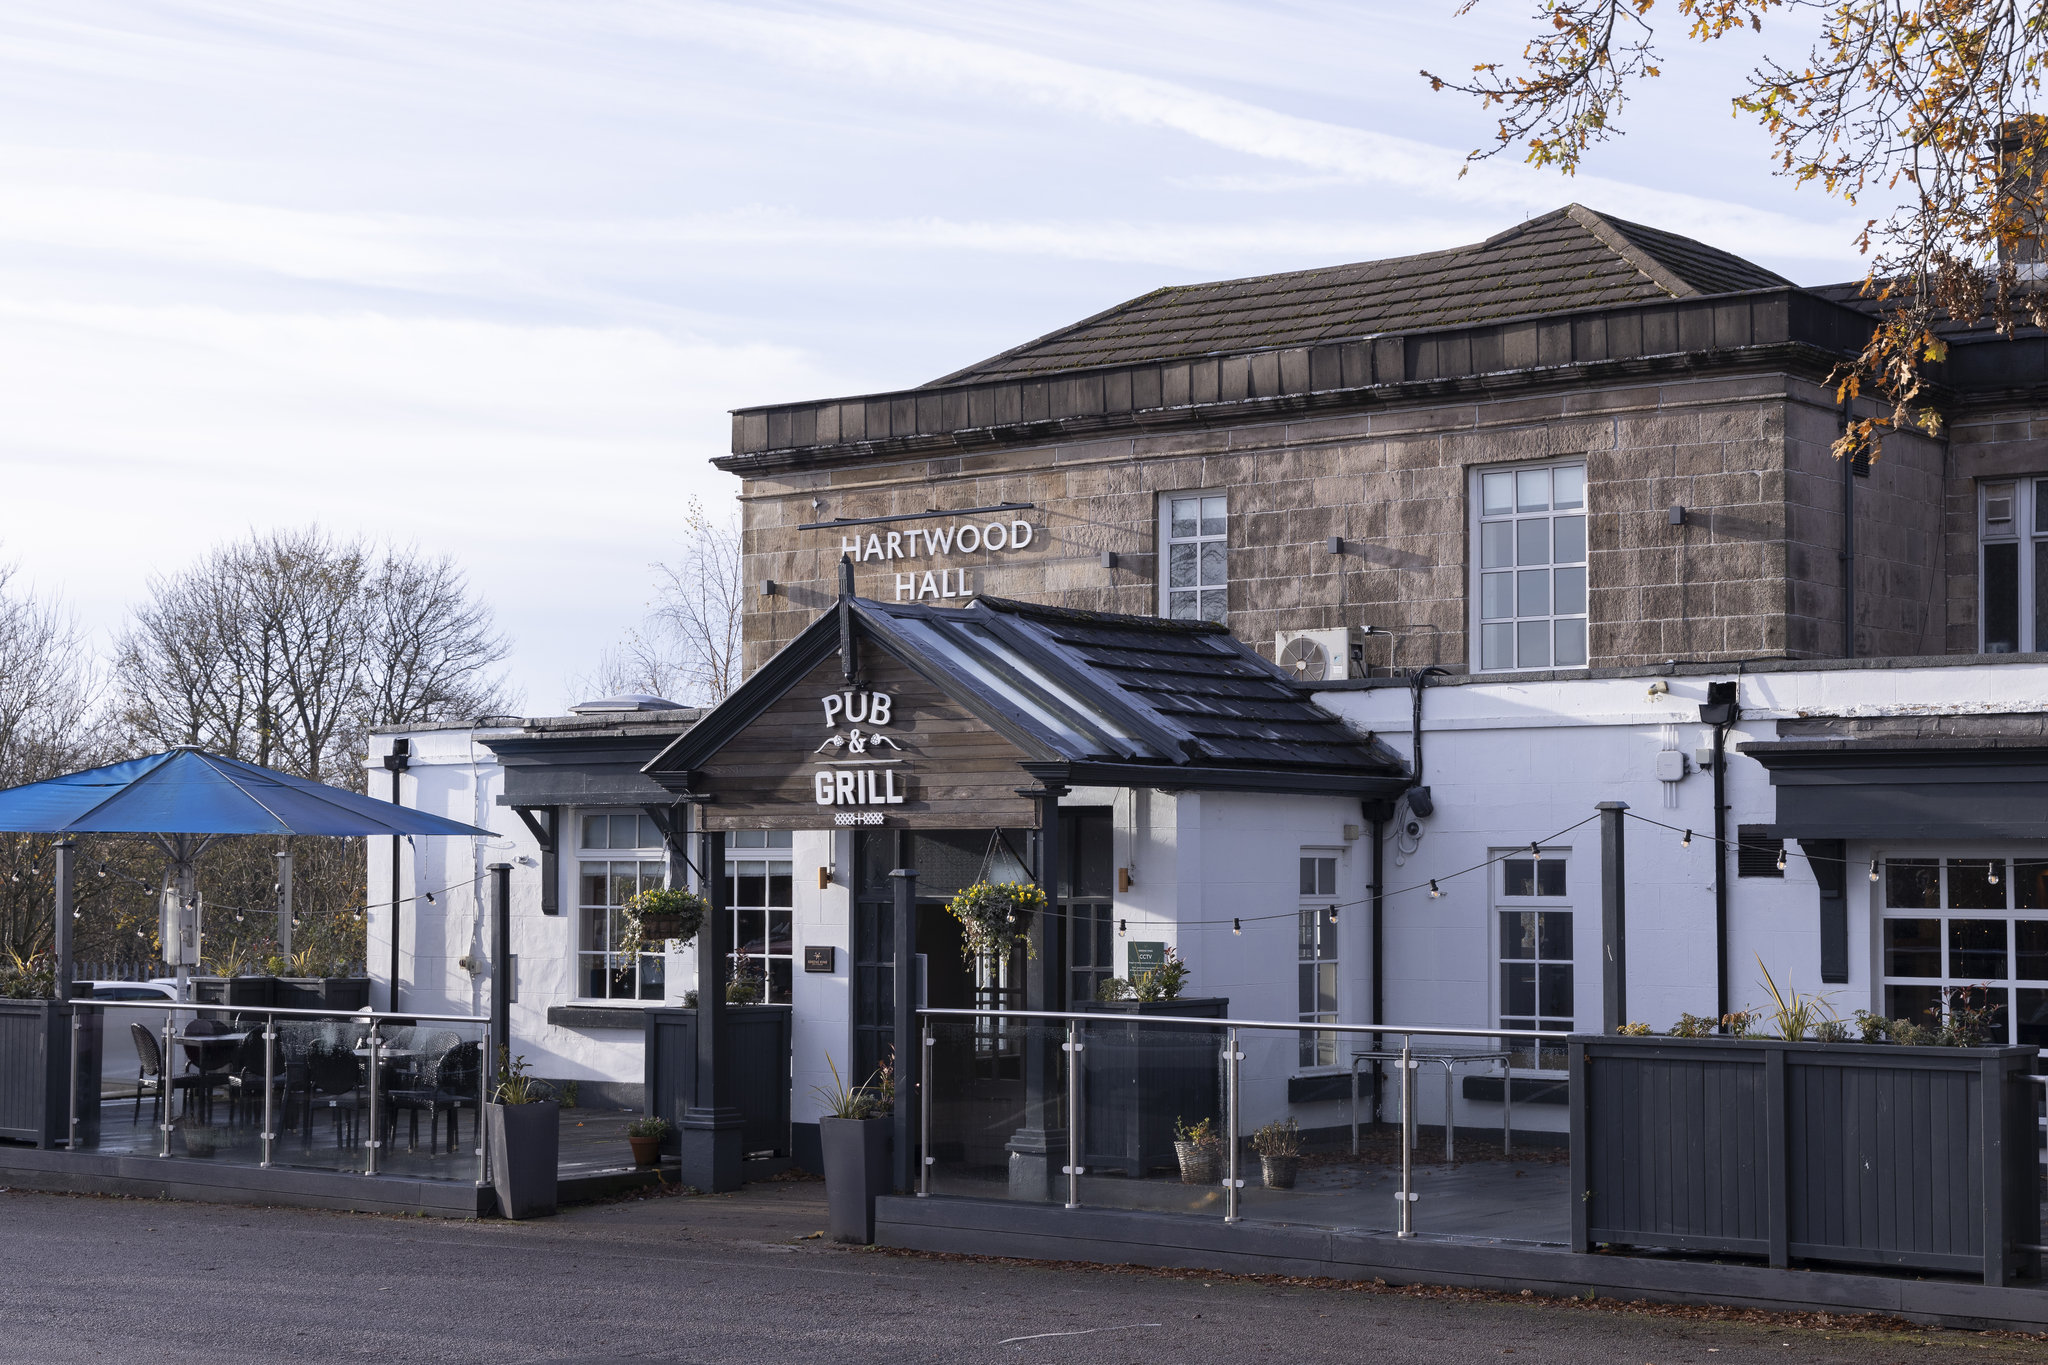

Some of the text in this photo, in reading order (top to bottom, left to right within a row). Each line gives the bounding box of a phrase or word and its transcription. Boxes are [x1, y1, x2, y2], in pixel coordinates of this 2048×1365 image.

[842, 521, 1033, 562] HARTWOOD
[895, 568, 973, 601] HALL
[821, 691, 892, 728] PUB
[848, 728, 867, 754] &
[815, 769, 903, 805] GRILL
